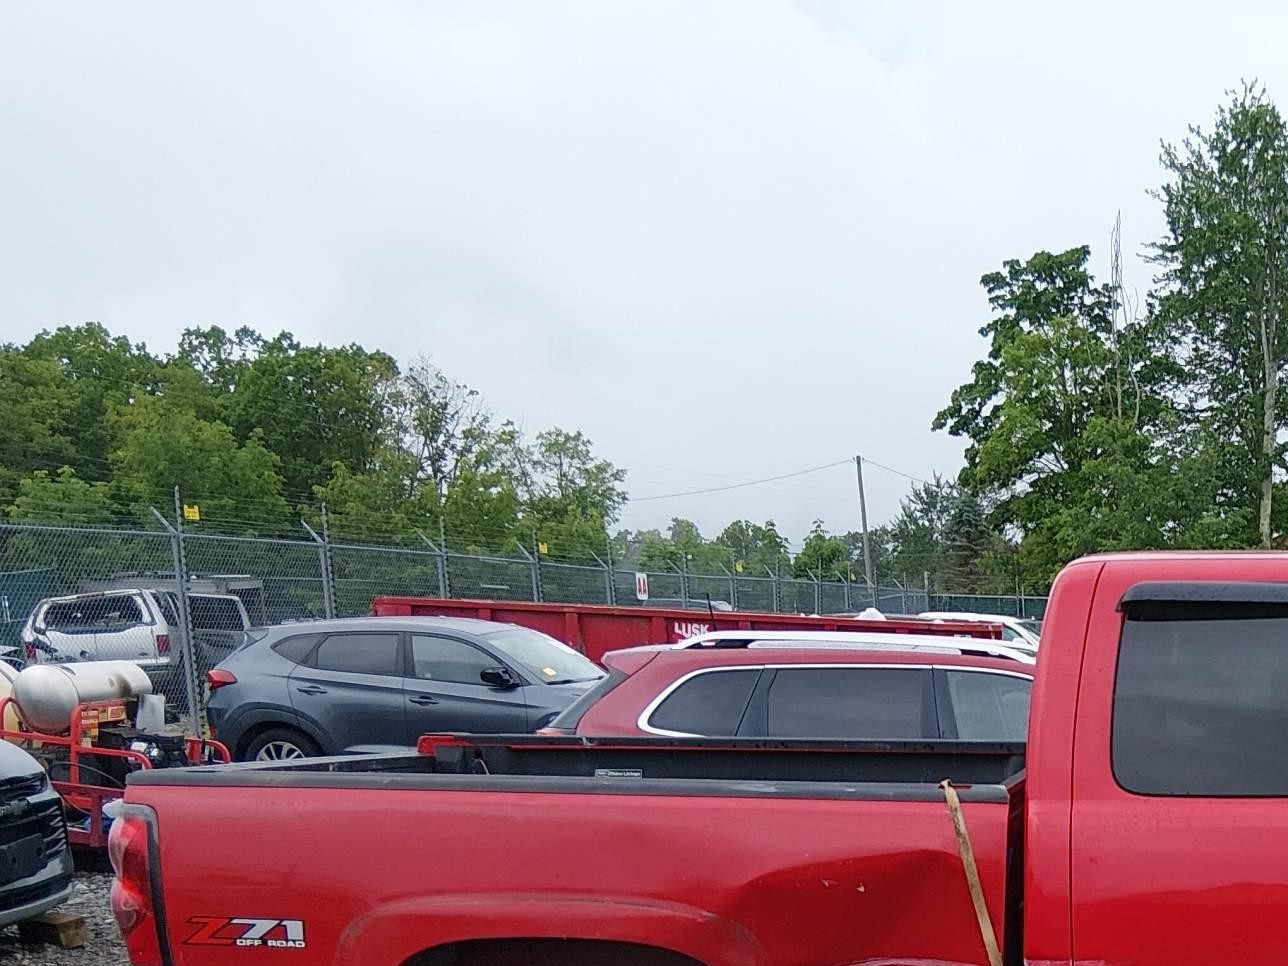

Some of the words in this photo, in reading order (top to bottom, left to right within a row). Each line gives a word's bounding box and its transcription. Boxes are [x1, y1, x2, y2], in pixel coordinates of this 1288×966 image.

[674, 622, 710, 639] LUSK
[182, 915, 305, 946] Z71
[236, 939, 263, 947] OFF
[267, 940, 306, 948] ROAD
